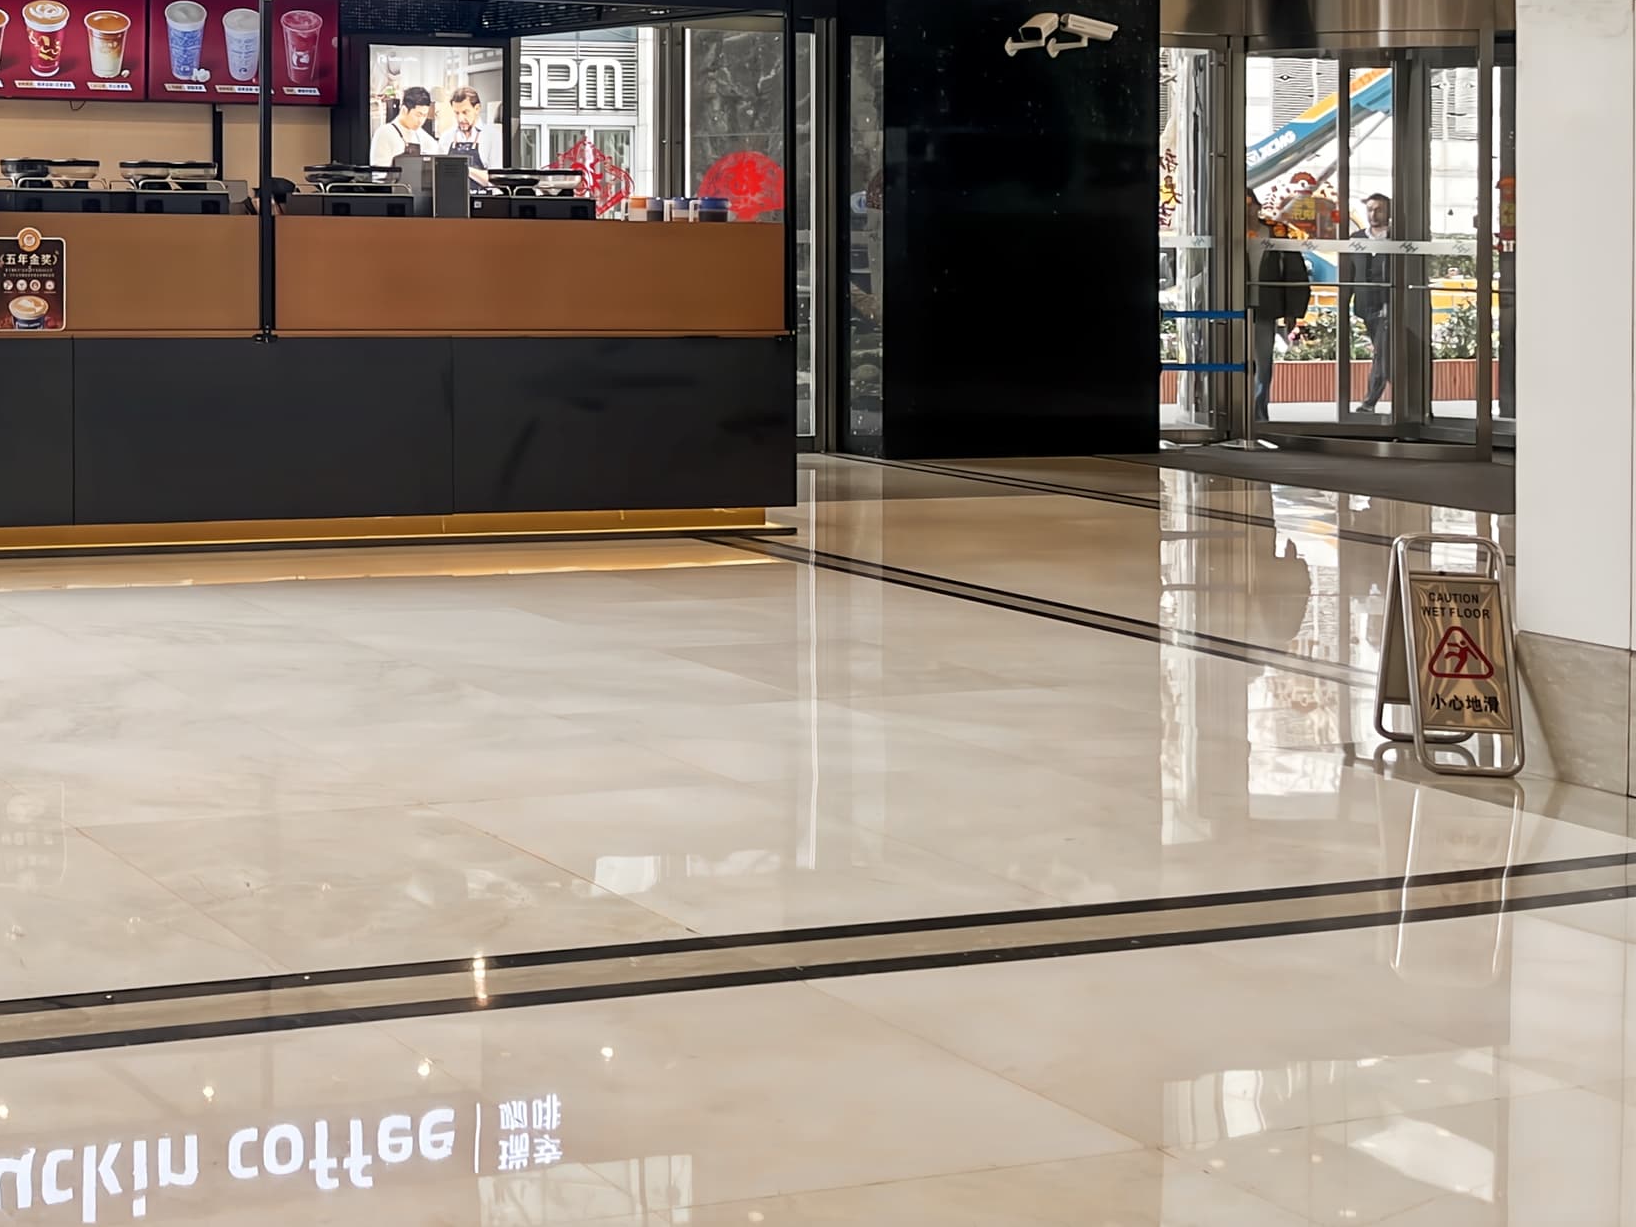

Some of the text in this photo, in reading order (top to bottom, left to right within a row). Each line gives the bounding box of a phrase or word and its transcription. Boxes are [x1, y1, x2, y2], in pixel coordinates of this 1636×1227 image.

[5, 253, 52, 266] 五年金奖
[1428, 592, 1480, 605] CAUTION
[1422, 606, 1491, 620] WET FLOOR
[1430, 692, 1500, 714] 小心地滑
